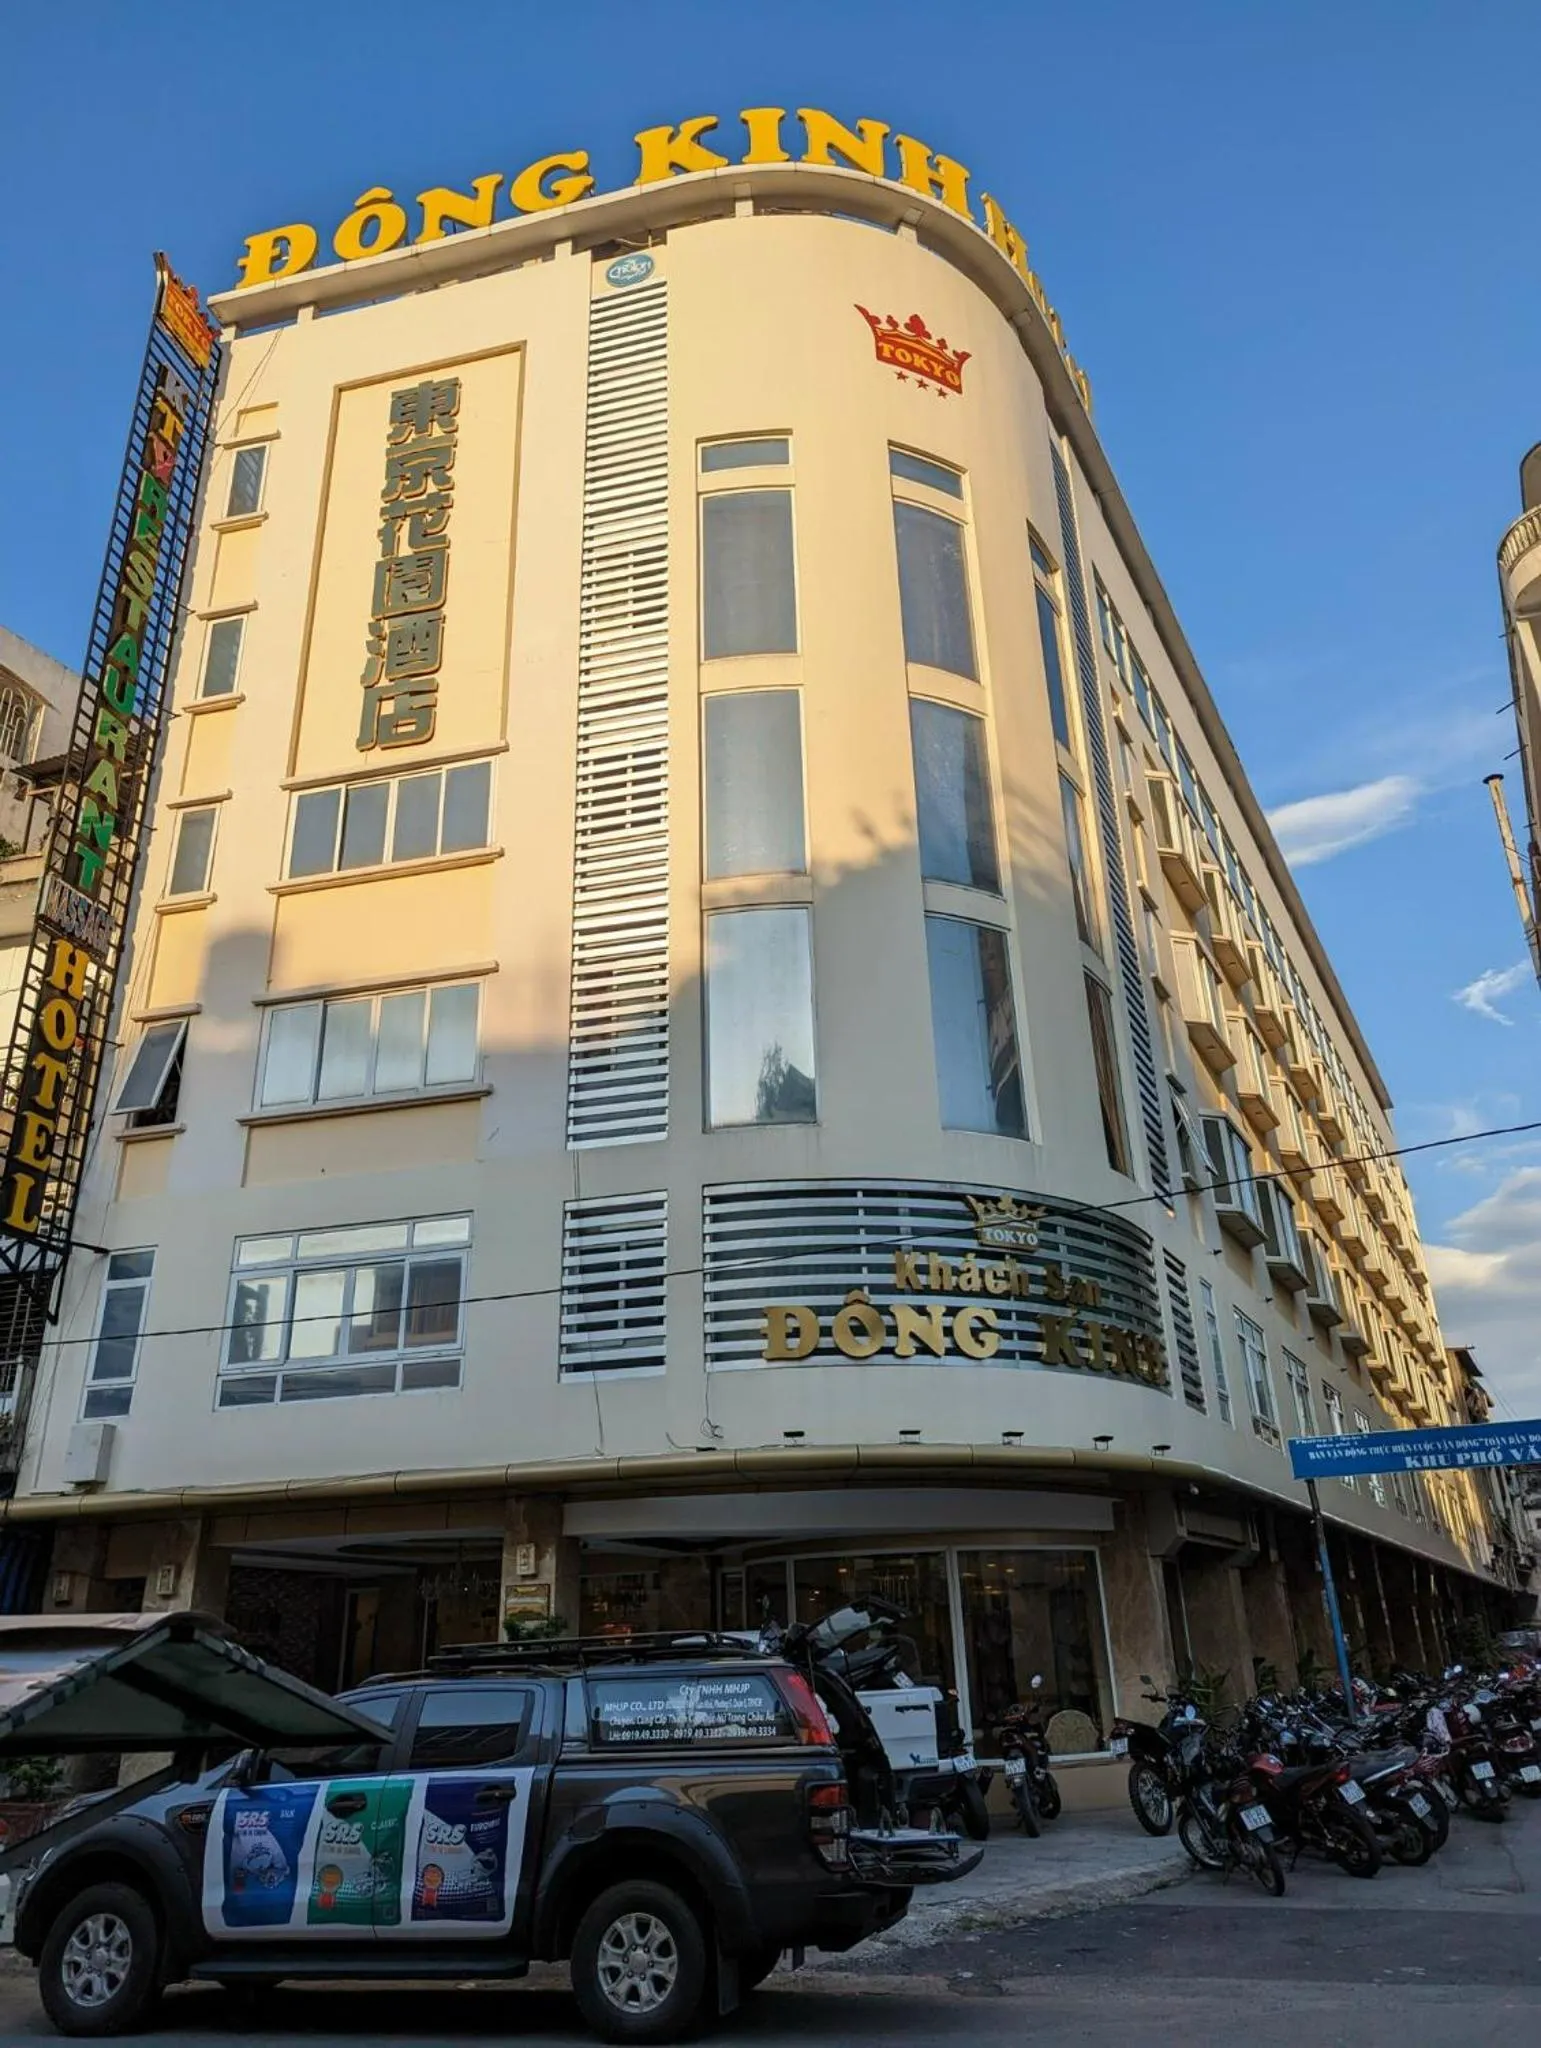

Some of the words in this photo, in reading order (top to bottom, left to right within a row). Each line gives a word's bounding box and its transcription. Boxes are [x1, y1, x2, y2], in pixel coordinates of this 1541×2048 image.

[235, 150, 594, 289] ĐÔNG
[633, 107, 975, 221] KINH
[878, 341, 960, 386] TOKYO
[356, 376, 462, 753] 東京花園酒店
[73, 470, 170, 892] RESTAURANT
[8, 938, 90, 1236] HOTEL
[983, 1227, 1038, 1245] TOKYO
[894, 1249, 1029, 1296] Khách
[761, 1289, 1002, 1361] ĐÔNG
[1404, 1454, 1452, 1469] KHU
[325, 1822, 364, 1845] SRS
[427, 1823, 467, 1845] SRS
